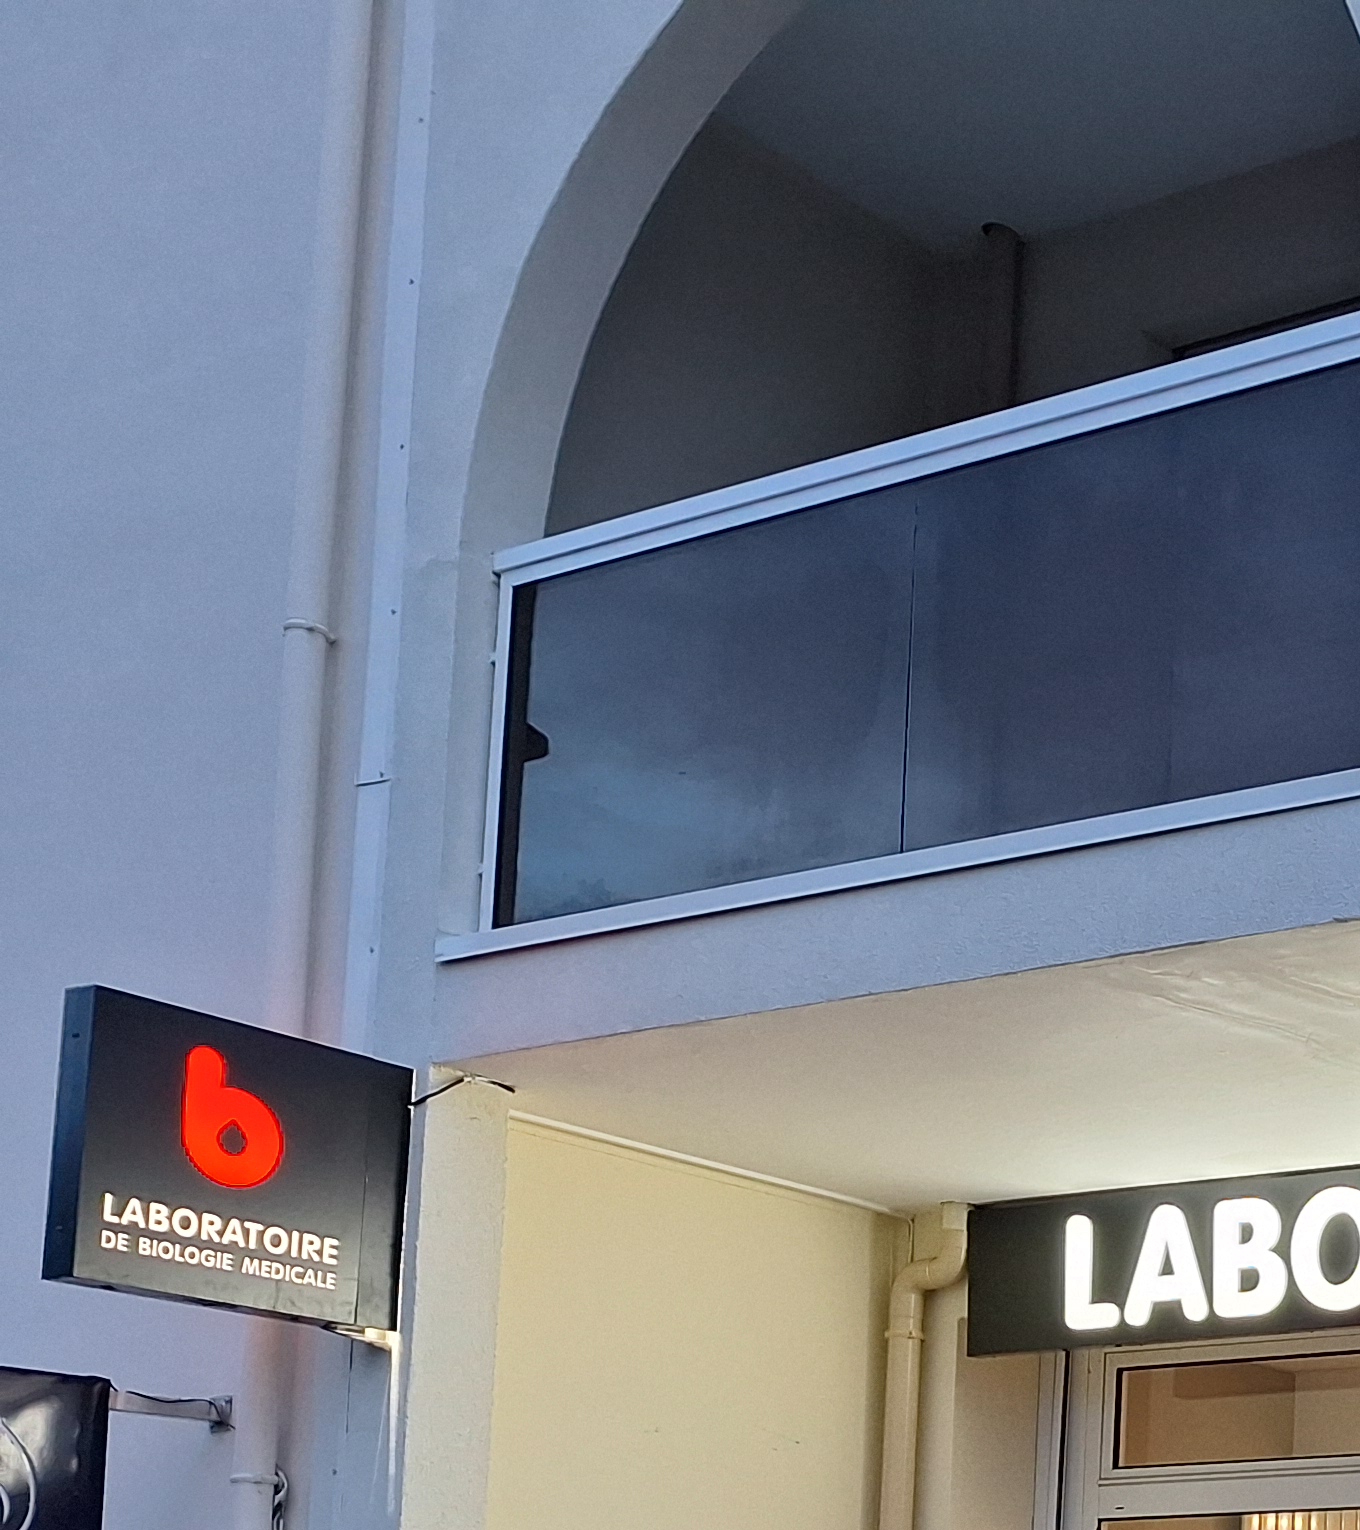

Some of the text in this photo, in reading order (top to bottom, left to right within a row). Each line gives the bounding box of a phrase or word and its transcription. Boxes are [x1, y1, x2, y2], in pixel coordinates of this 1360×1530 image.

[100, 1229, 337, 1290] DE BIOLOGIE MEDICALE
[102, 1192, 341, 1266] LABORATOIRE
